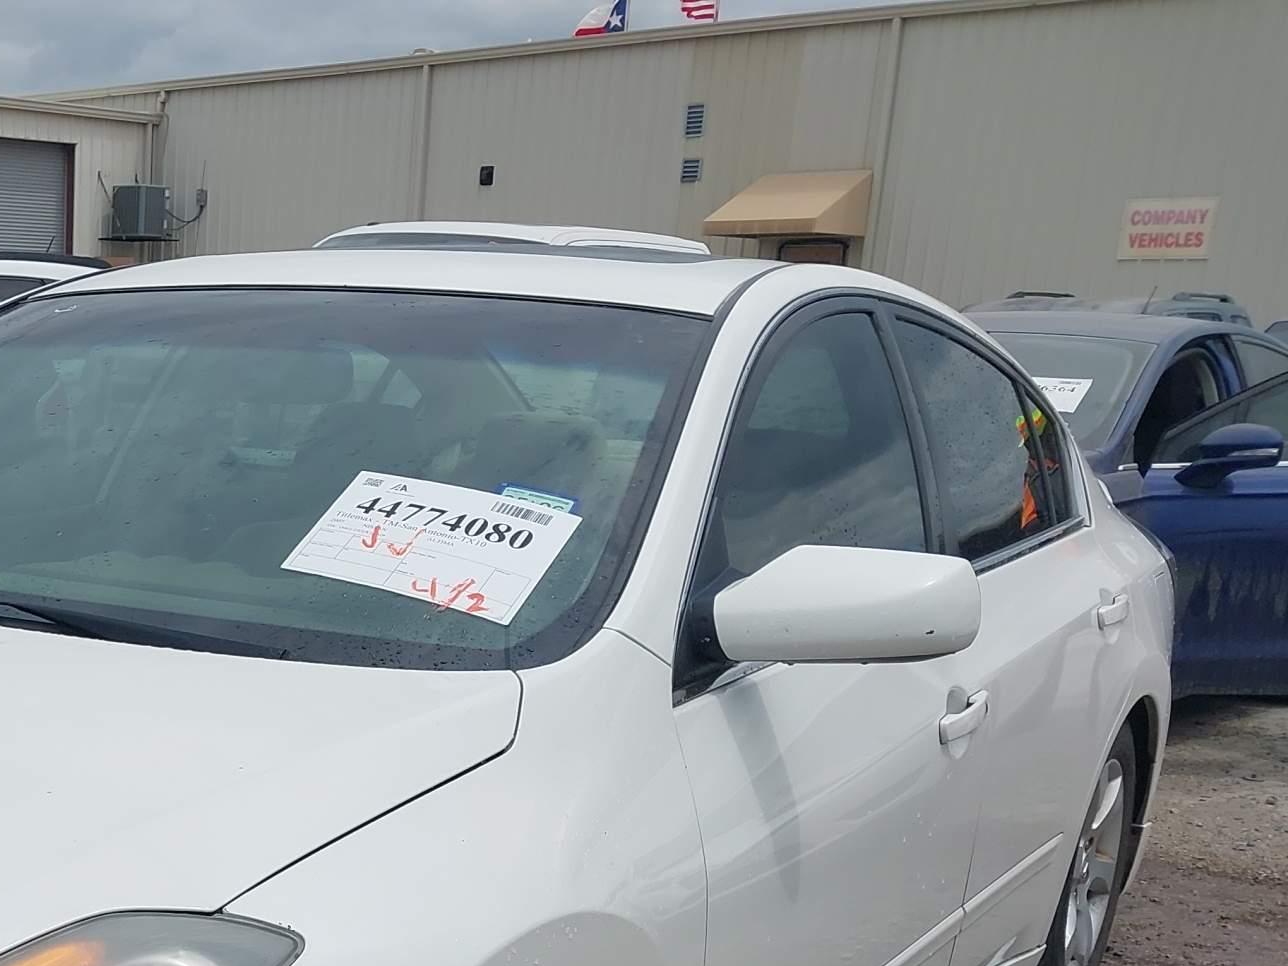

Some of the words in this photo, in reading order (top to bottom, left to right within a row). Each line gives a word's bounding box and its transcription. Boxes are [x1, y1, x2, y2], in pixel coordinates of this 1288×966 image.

[1130, 208, 1209, 226] COMPANY
[1128, 231, 1204, 249] VEHICLES
[335, 510, 374, 523] Titlemax
[355, 496, 534, 550] 44774080
[411, 576, 490, 613] 4/2
